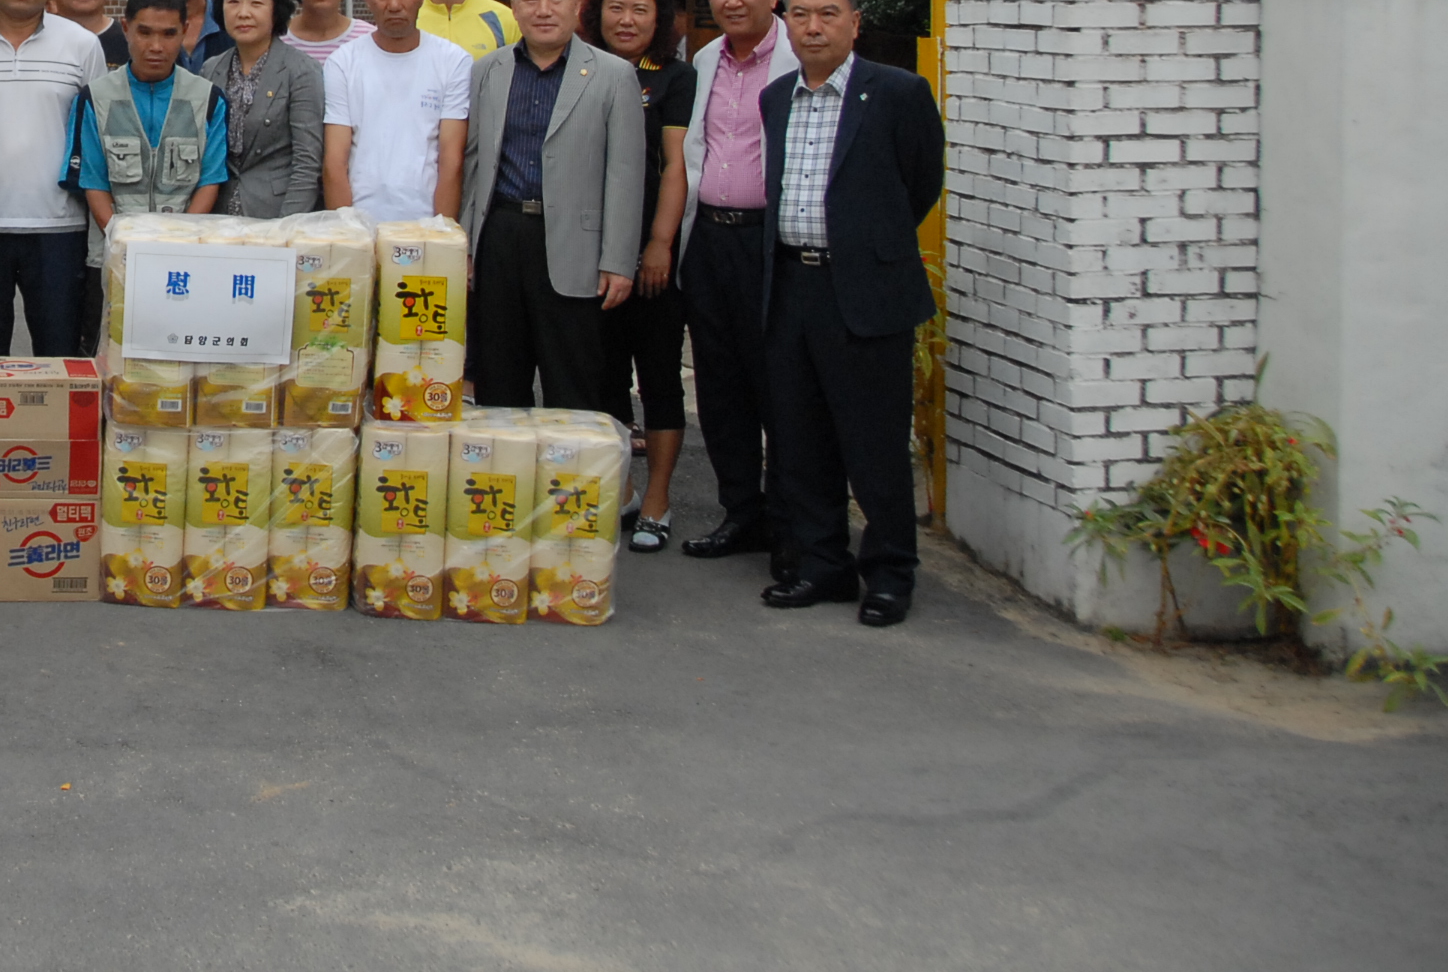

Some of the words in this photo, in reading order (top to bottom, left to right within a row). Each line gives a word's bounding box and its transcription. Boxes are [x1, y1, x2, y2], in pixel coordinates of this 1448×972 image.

[165, 271, 256, 300] 慰問
[305, 282, 351, 328] 황토
[395, 281, 448, 335] 황토
[184, 335, 249, 347] 담양군의회
[57, 505, 92, 521] 멀티팩
[117, 466, 168, 520] 황토
[197, 467, 249, 520] 황토
[281, 468, 334, 521] 황토
[376, 476, 430, 529] 황토
[463, 478, 517, 532] 황토
[548, 478, 600, 533] 황토
